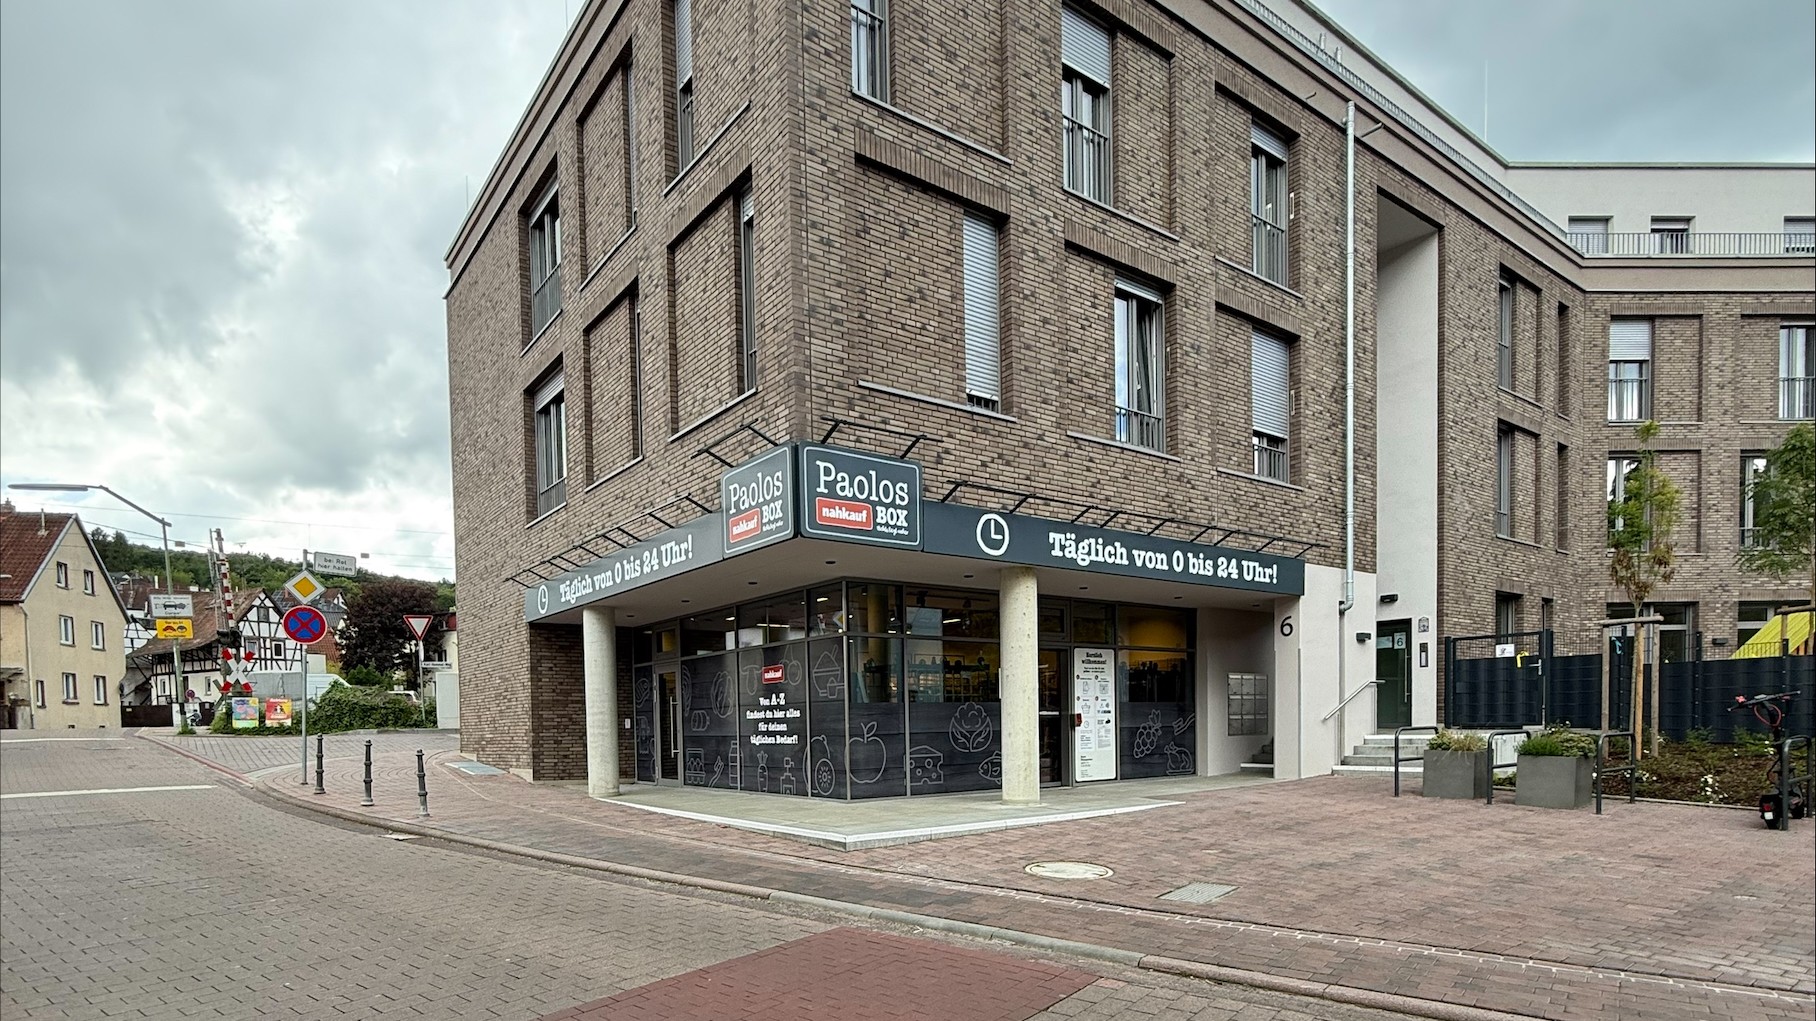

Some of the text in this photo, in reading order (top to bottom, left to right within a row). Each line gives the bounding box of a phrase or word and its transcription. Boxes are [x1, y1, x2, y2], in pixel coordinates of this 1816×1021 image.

[729, 470, 783, 515] Paolos
[815, 460, 909, 506] Paolos
[761, 500, 784, 524] BOX
[821, 505, 868, 523] nahkauf
[875, 505, 909, 527] BOX
[732, 515, 759, 536] nahkauf
[1048, 531, 1279, 584] Täglich von 0 bis 24 Uhr!
[559, 534, 693, 605] Täglich von 0 bis 24 Uhr!
[1280, 615, 1294, 637] 6
[1397, 637, 1403, 646] 6
[759, 697, 770, 706] Von
[786, 709, 800, 717] alles
